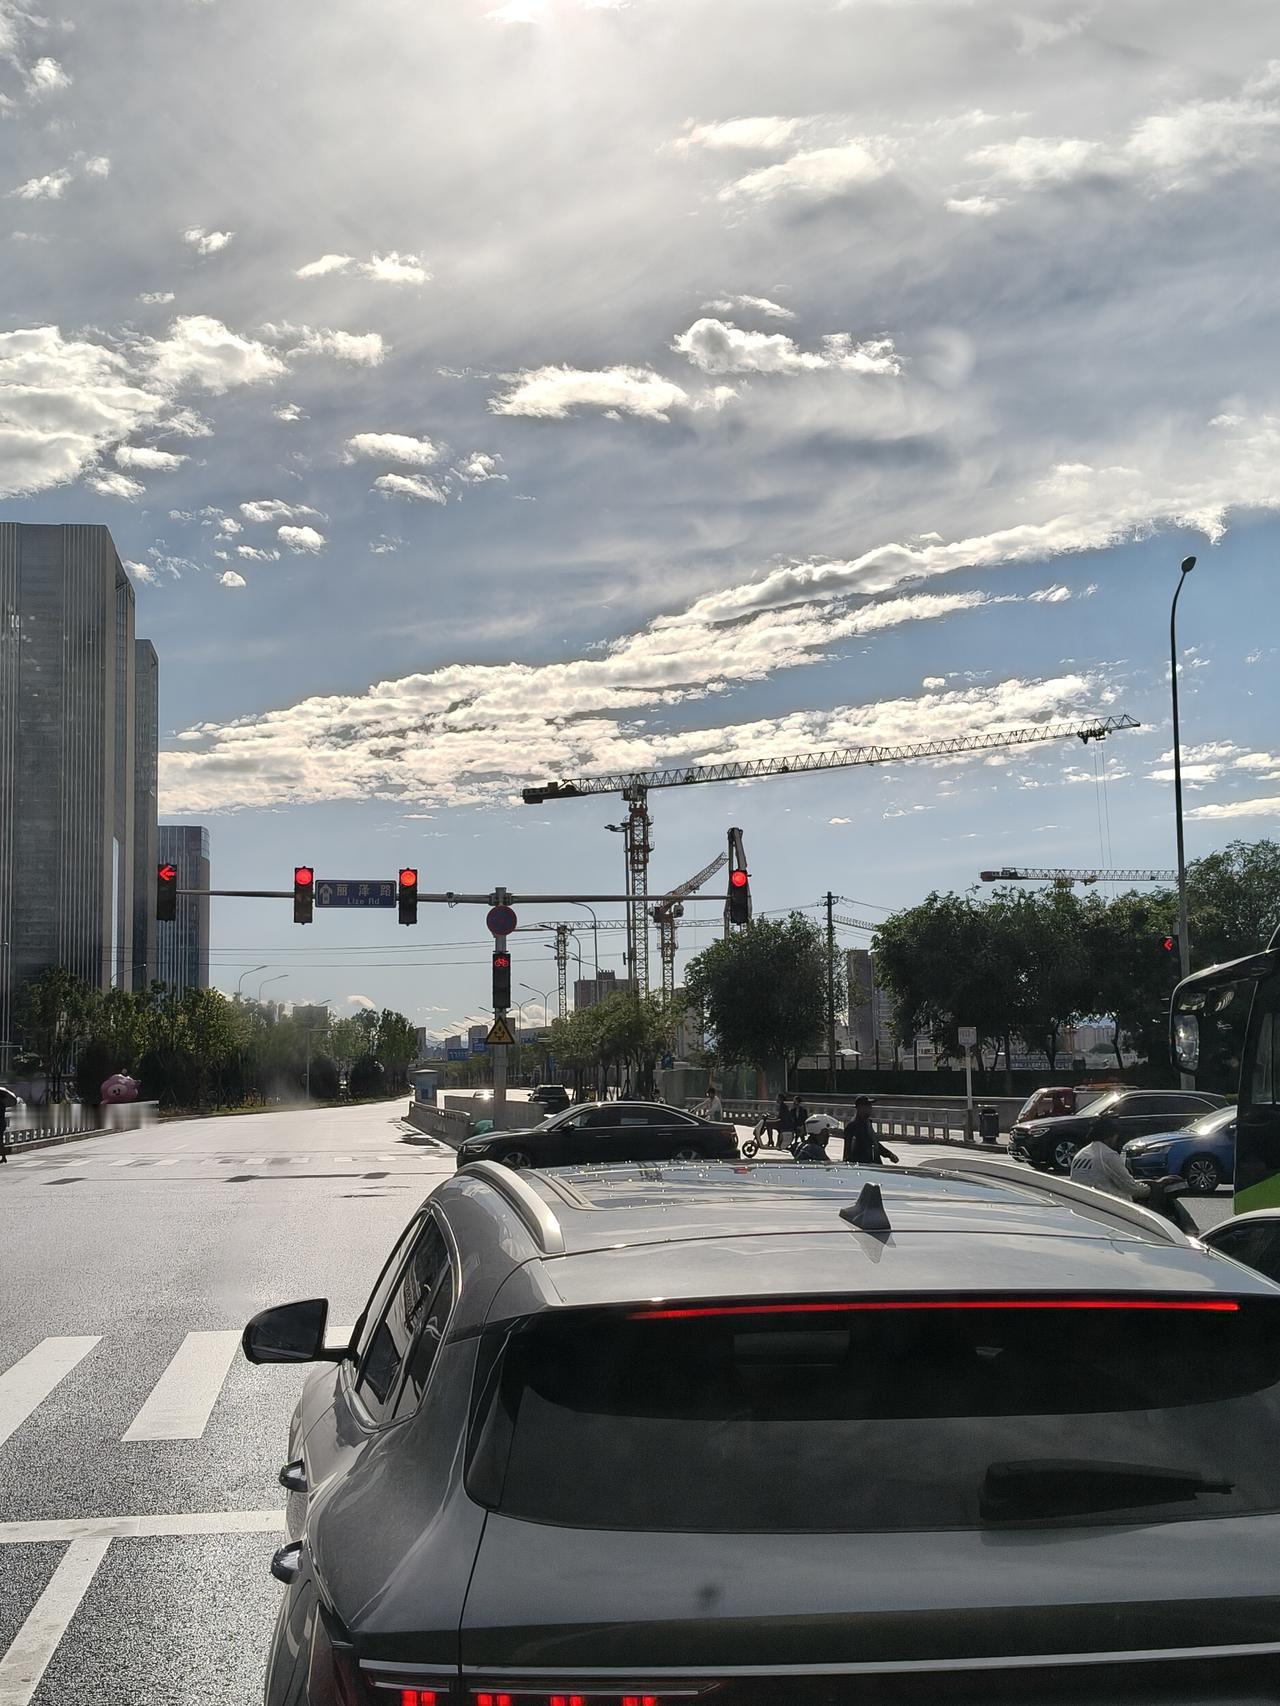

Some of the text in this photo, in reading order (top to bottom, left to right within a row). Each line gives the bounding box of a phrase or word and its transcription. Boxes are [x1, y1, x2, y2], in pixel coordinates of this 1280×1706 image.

[336, 883, 391, 896] 丽泽路
[347, 897, 380, 905] Lize Rd
